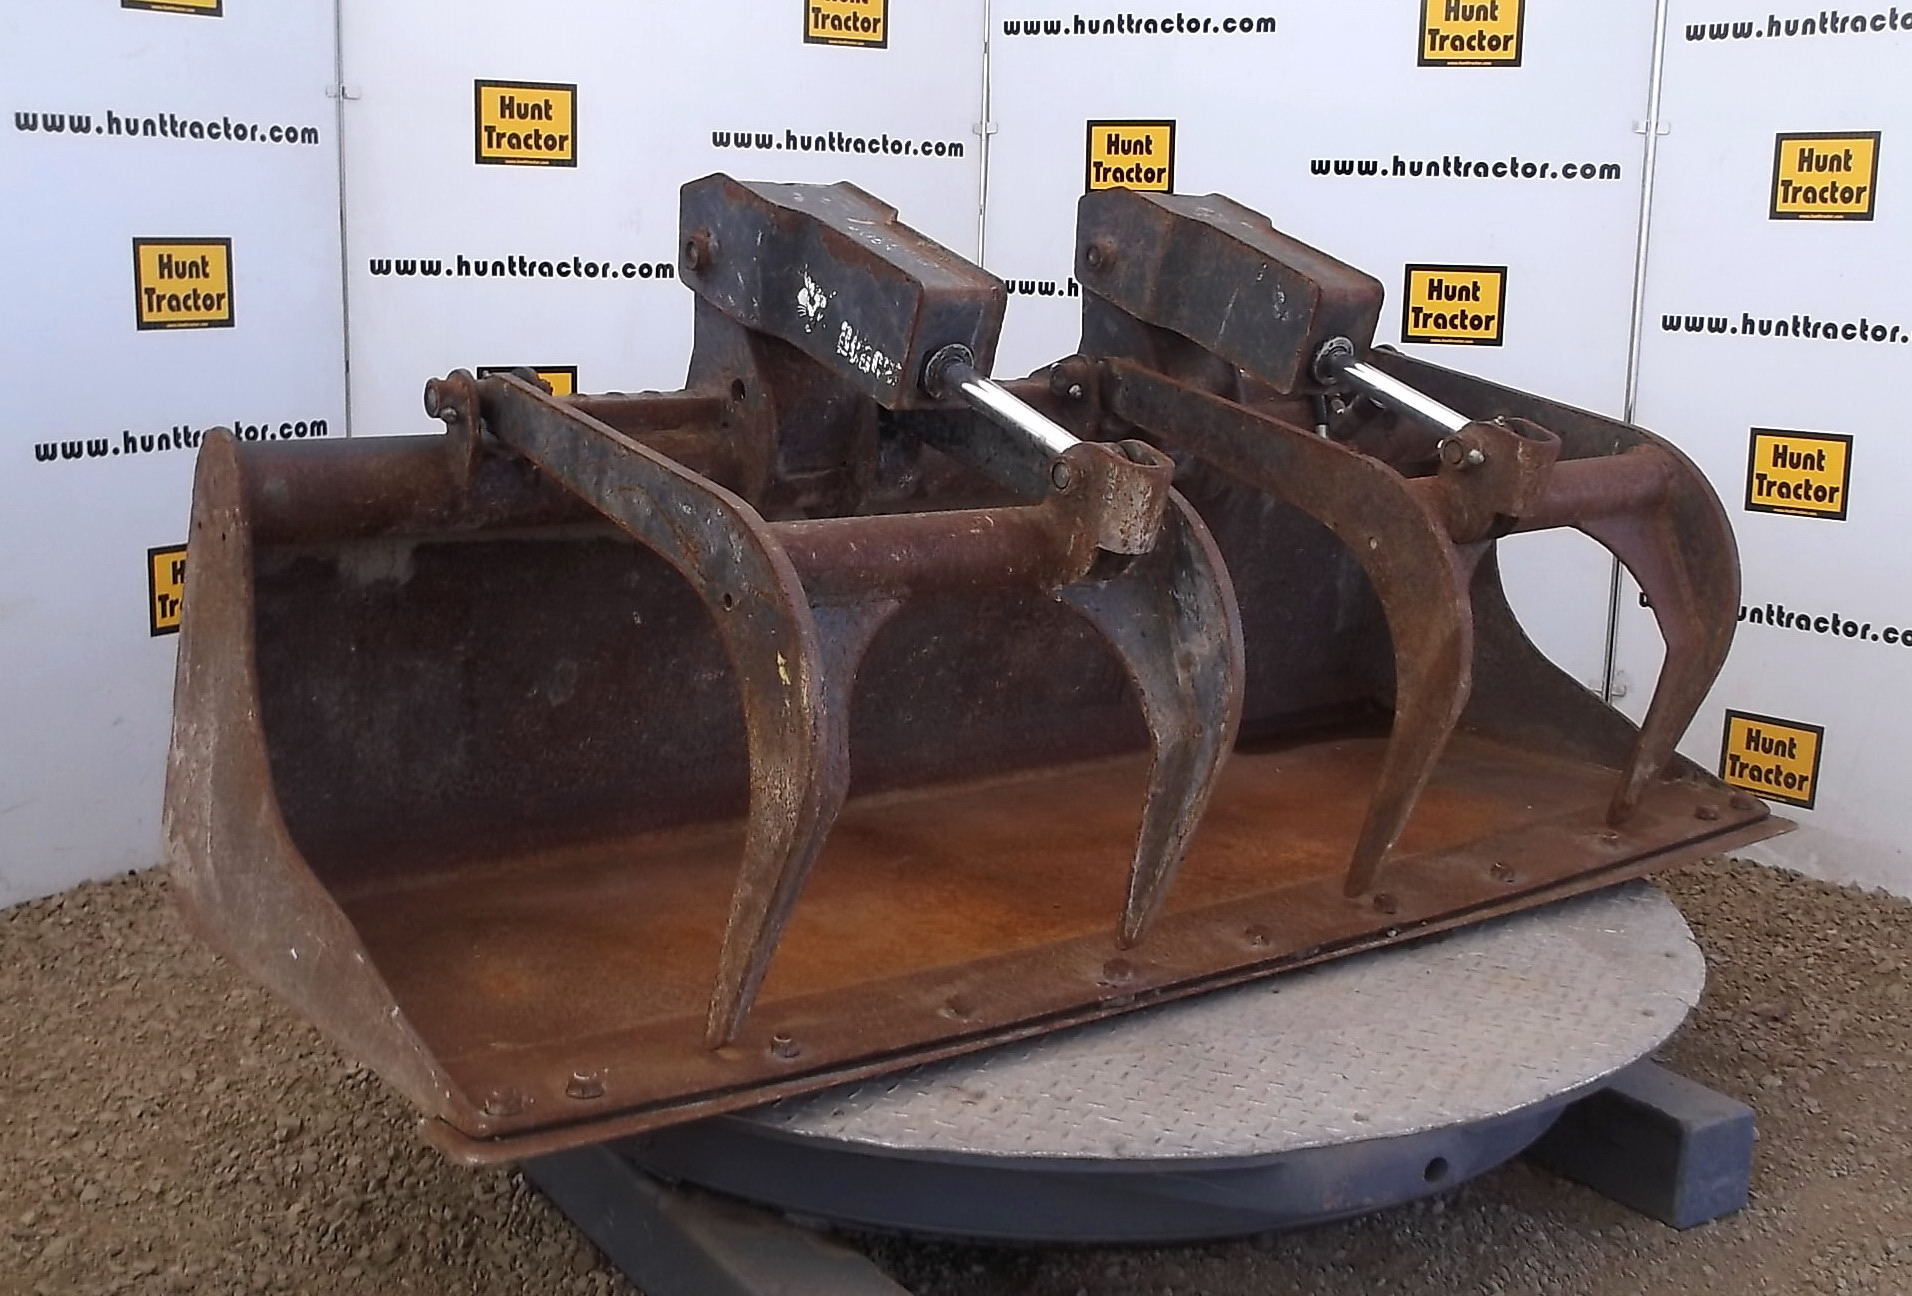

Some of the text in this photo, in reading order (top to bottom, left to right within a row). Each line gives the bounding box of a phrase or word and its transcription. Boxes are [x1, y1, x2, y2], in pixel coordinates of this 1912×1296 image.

[811, 6, 881, 34] Tractor
[1003, 12, 1276, 36] www.hunttractor.com
[1444, 0, 1499, 22] Hunt
[1427, 28, 1514, 52] Tractor
[499, 95, 553, 121] Hunt
[15, 110, 319, 145] www.hunttractor.com
[483, 125, 569, 152] Tractor
[712, 129, 964, 158] www.hunttractor.com
[1106, 133, 1153, 156] Hunt
[1092, 161, 1167, 184] Tractor
[1310, 155, 1621, 180] www.hunttractor.com
[1797, 147, 1853, 173] Hunt
[1780, 179, 1867, 205] Tractor
[158, 253, 210, 280] Hunt
[369, 254, 675, 279] www.hunttractor.com
[143, 287, 226, 313] Tractor
[1427, 278, 1481, 302] Hunt
[1411, 306, 1496, 331] Tractor
[34, 419, 328, 462] www.hunttrtor.com
[1772, 443, 1826, 472] Hunt
[1755, 472, 1840, 504] Tractor
[1745, 727, 1797, 760] Hunt
[1728, 752, 1810, 792] Tractor
